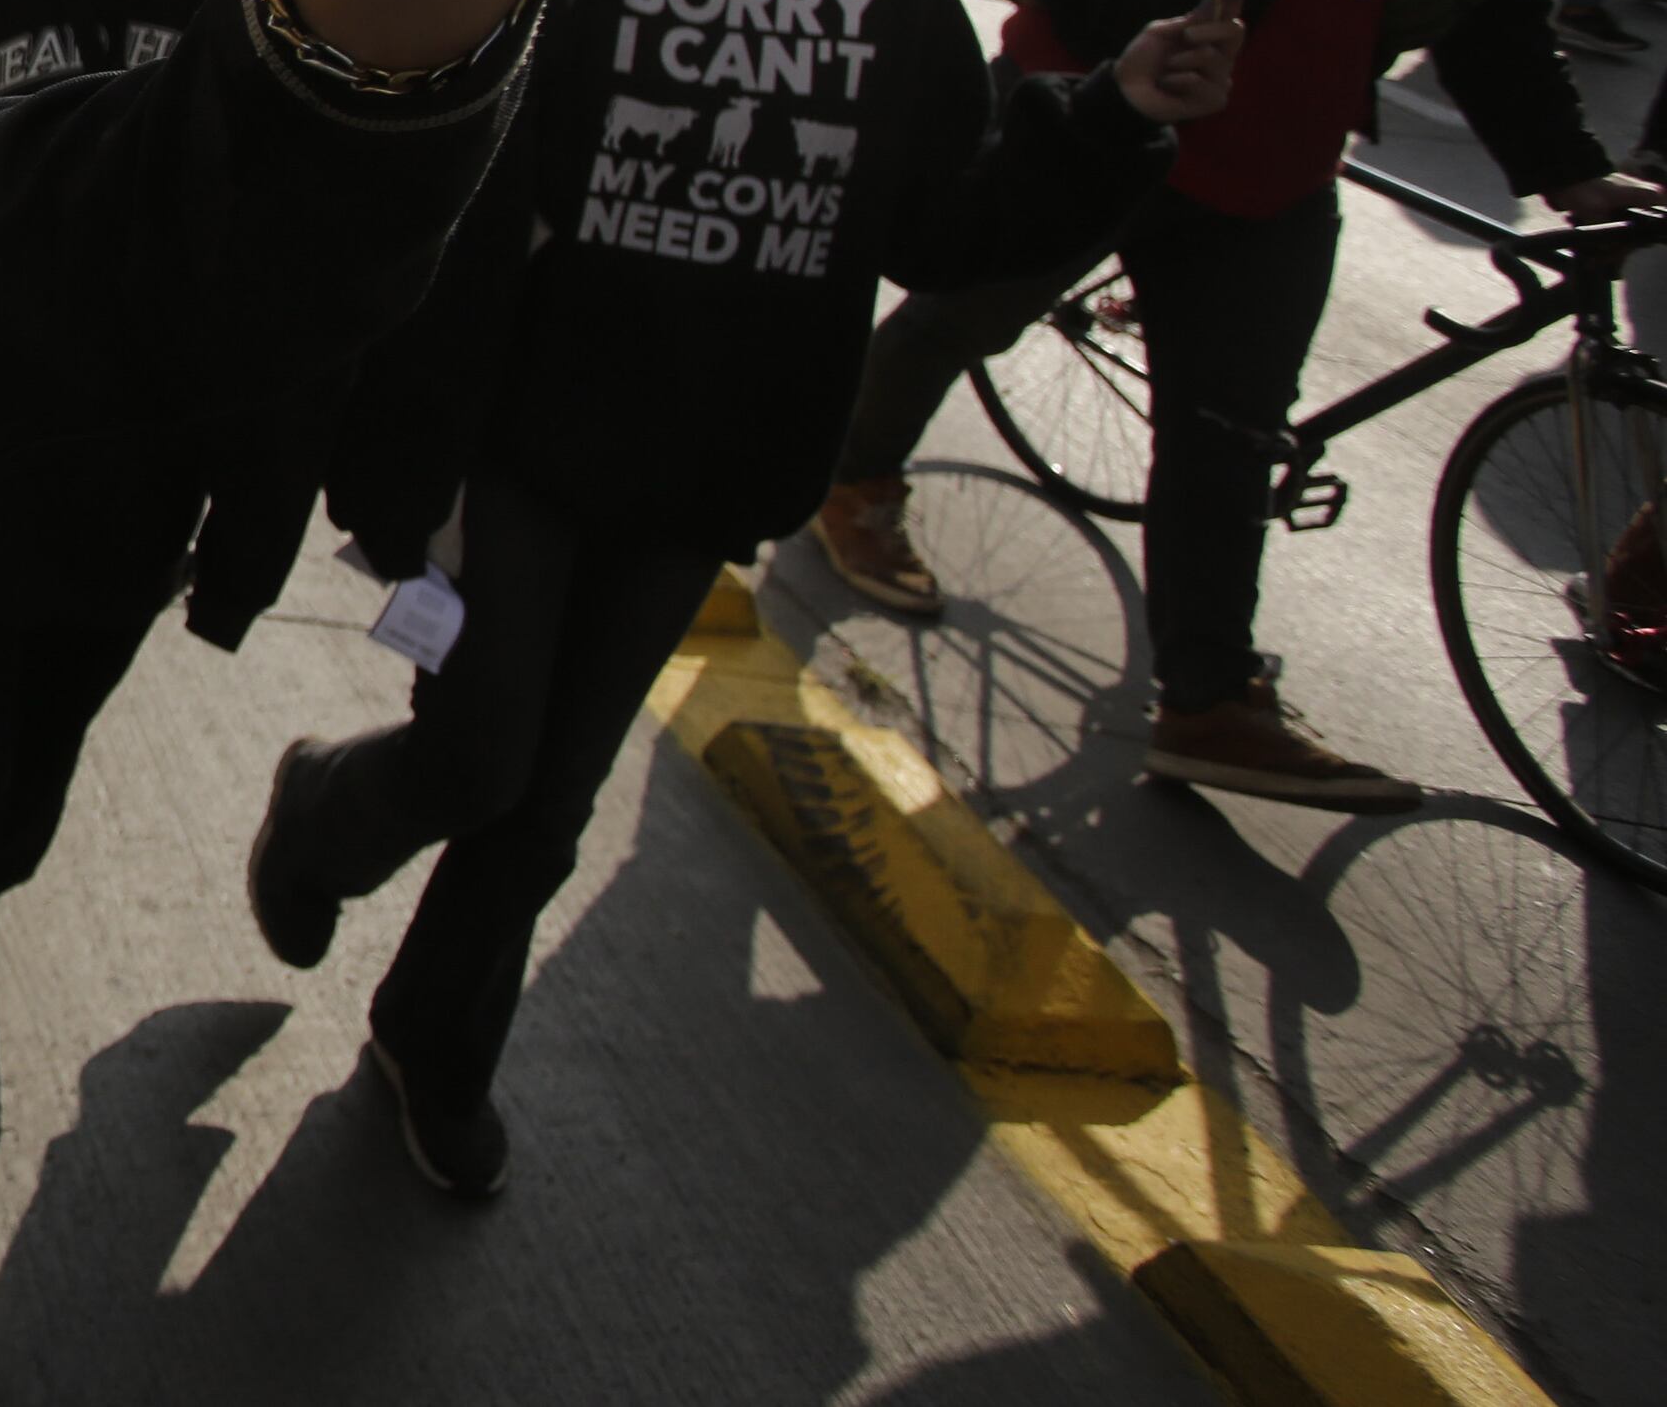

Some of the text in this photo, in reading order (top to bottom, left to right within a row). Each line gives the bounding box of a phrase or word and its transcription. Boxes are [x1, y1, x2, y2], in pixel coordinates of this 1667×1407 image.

[613, 16, 876, 100] I CAN'T
[589, 155, 842, 225] MY COWS
[577, 197, 833, 276] NEED ME
